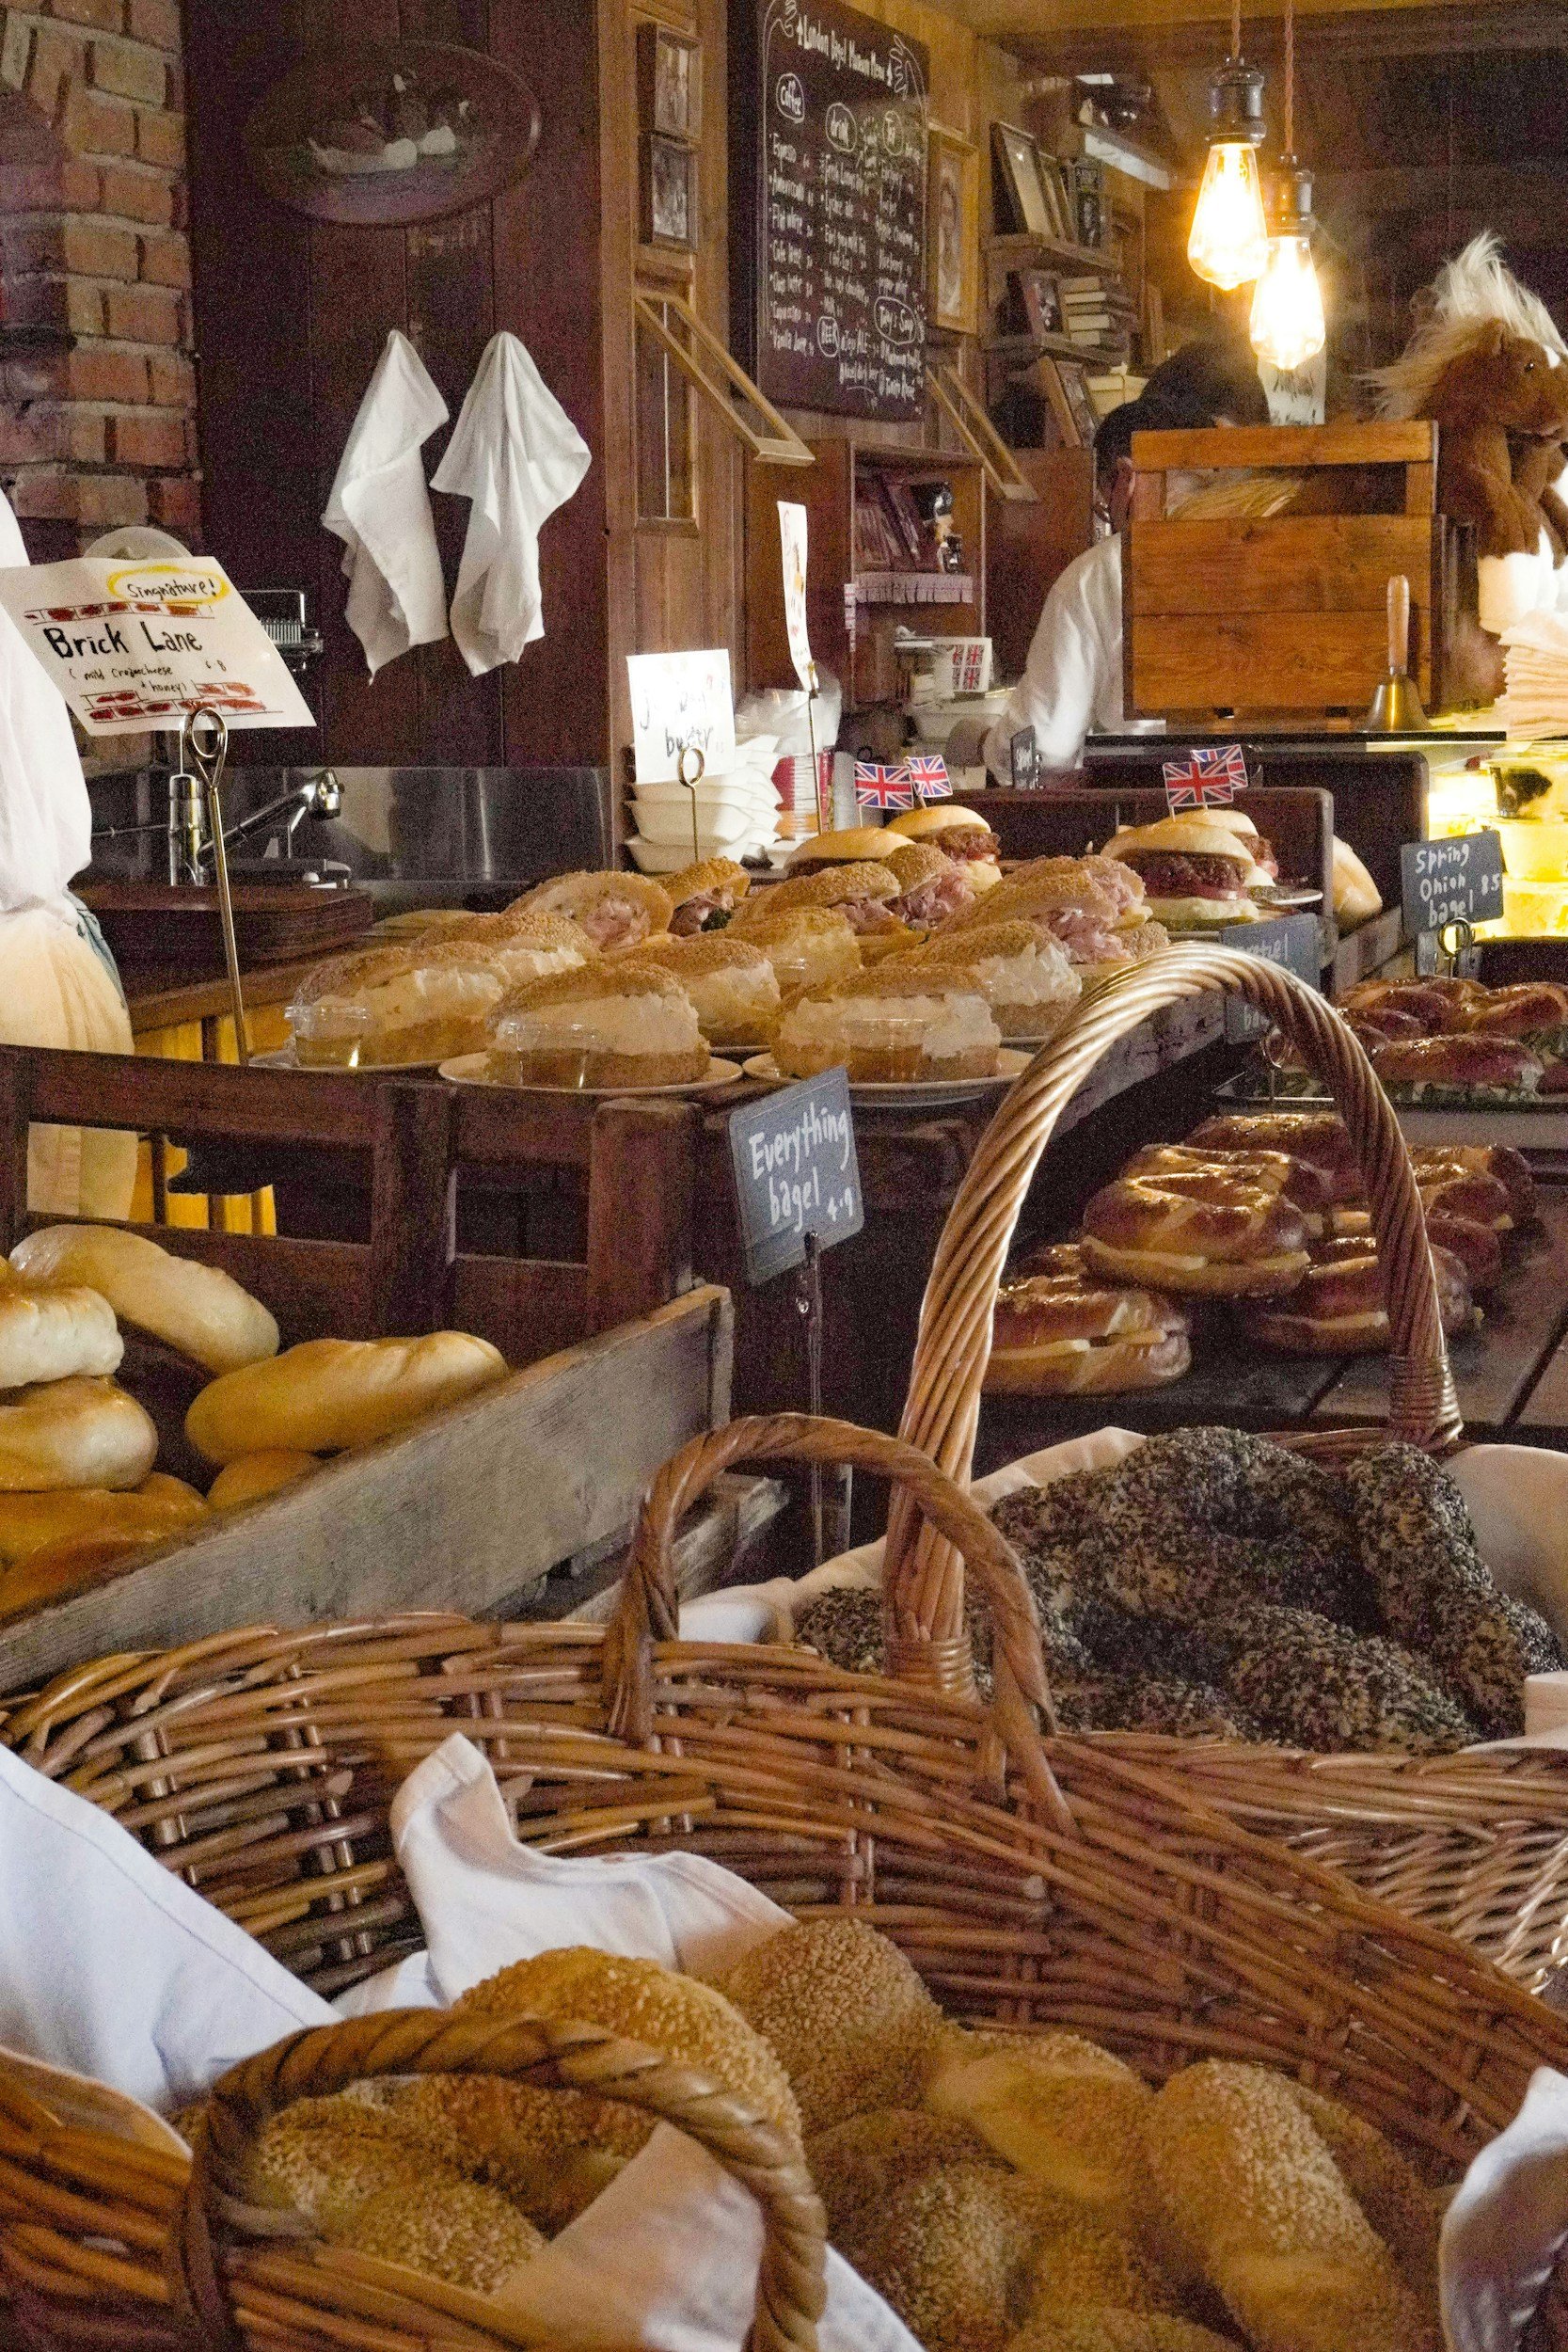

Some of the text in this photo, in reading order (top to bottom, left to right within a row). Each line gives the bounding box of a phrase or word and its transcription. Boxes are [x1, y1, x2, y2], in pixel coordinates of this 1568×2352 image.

[43, 620, 203, 659] Brick Lane
[1415, 843, 1470, 875] Spring
[1429, 888, 1474, 929] bagel
[748, 1101, 850, 1180] Everything
[768, 1166, 820, 1233] bagel
